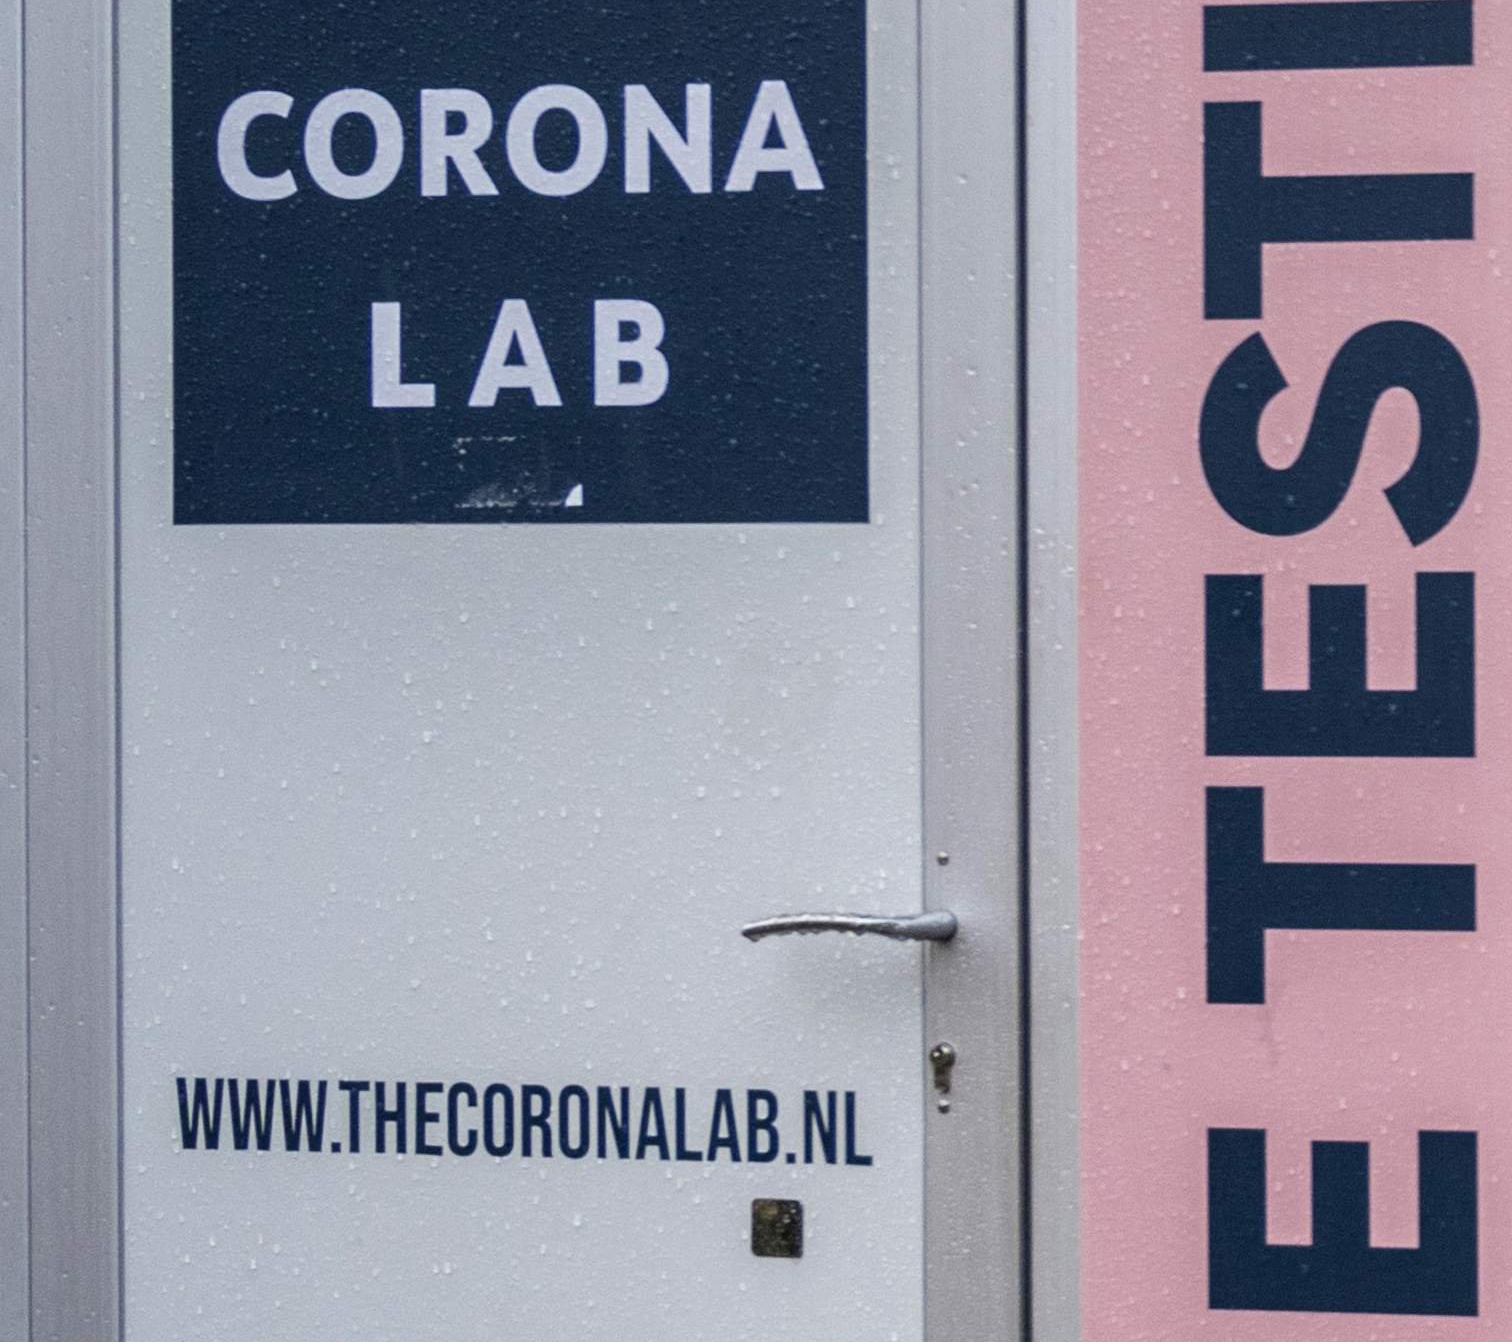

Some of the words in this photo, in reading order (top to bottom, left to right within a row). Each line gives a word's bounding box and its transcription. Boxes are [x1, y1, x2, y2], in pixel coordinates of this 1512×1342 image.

[216, 79, 825, 201] CORONA
[370, 298, 671, 408] LAB
[175, 1076, 874, 1167] WWW.THECORONALAB.NL
